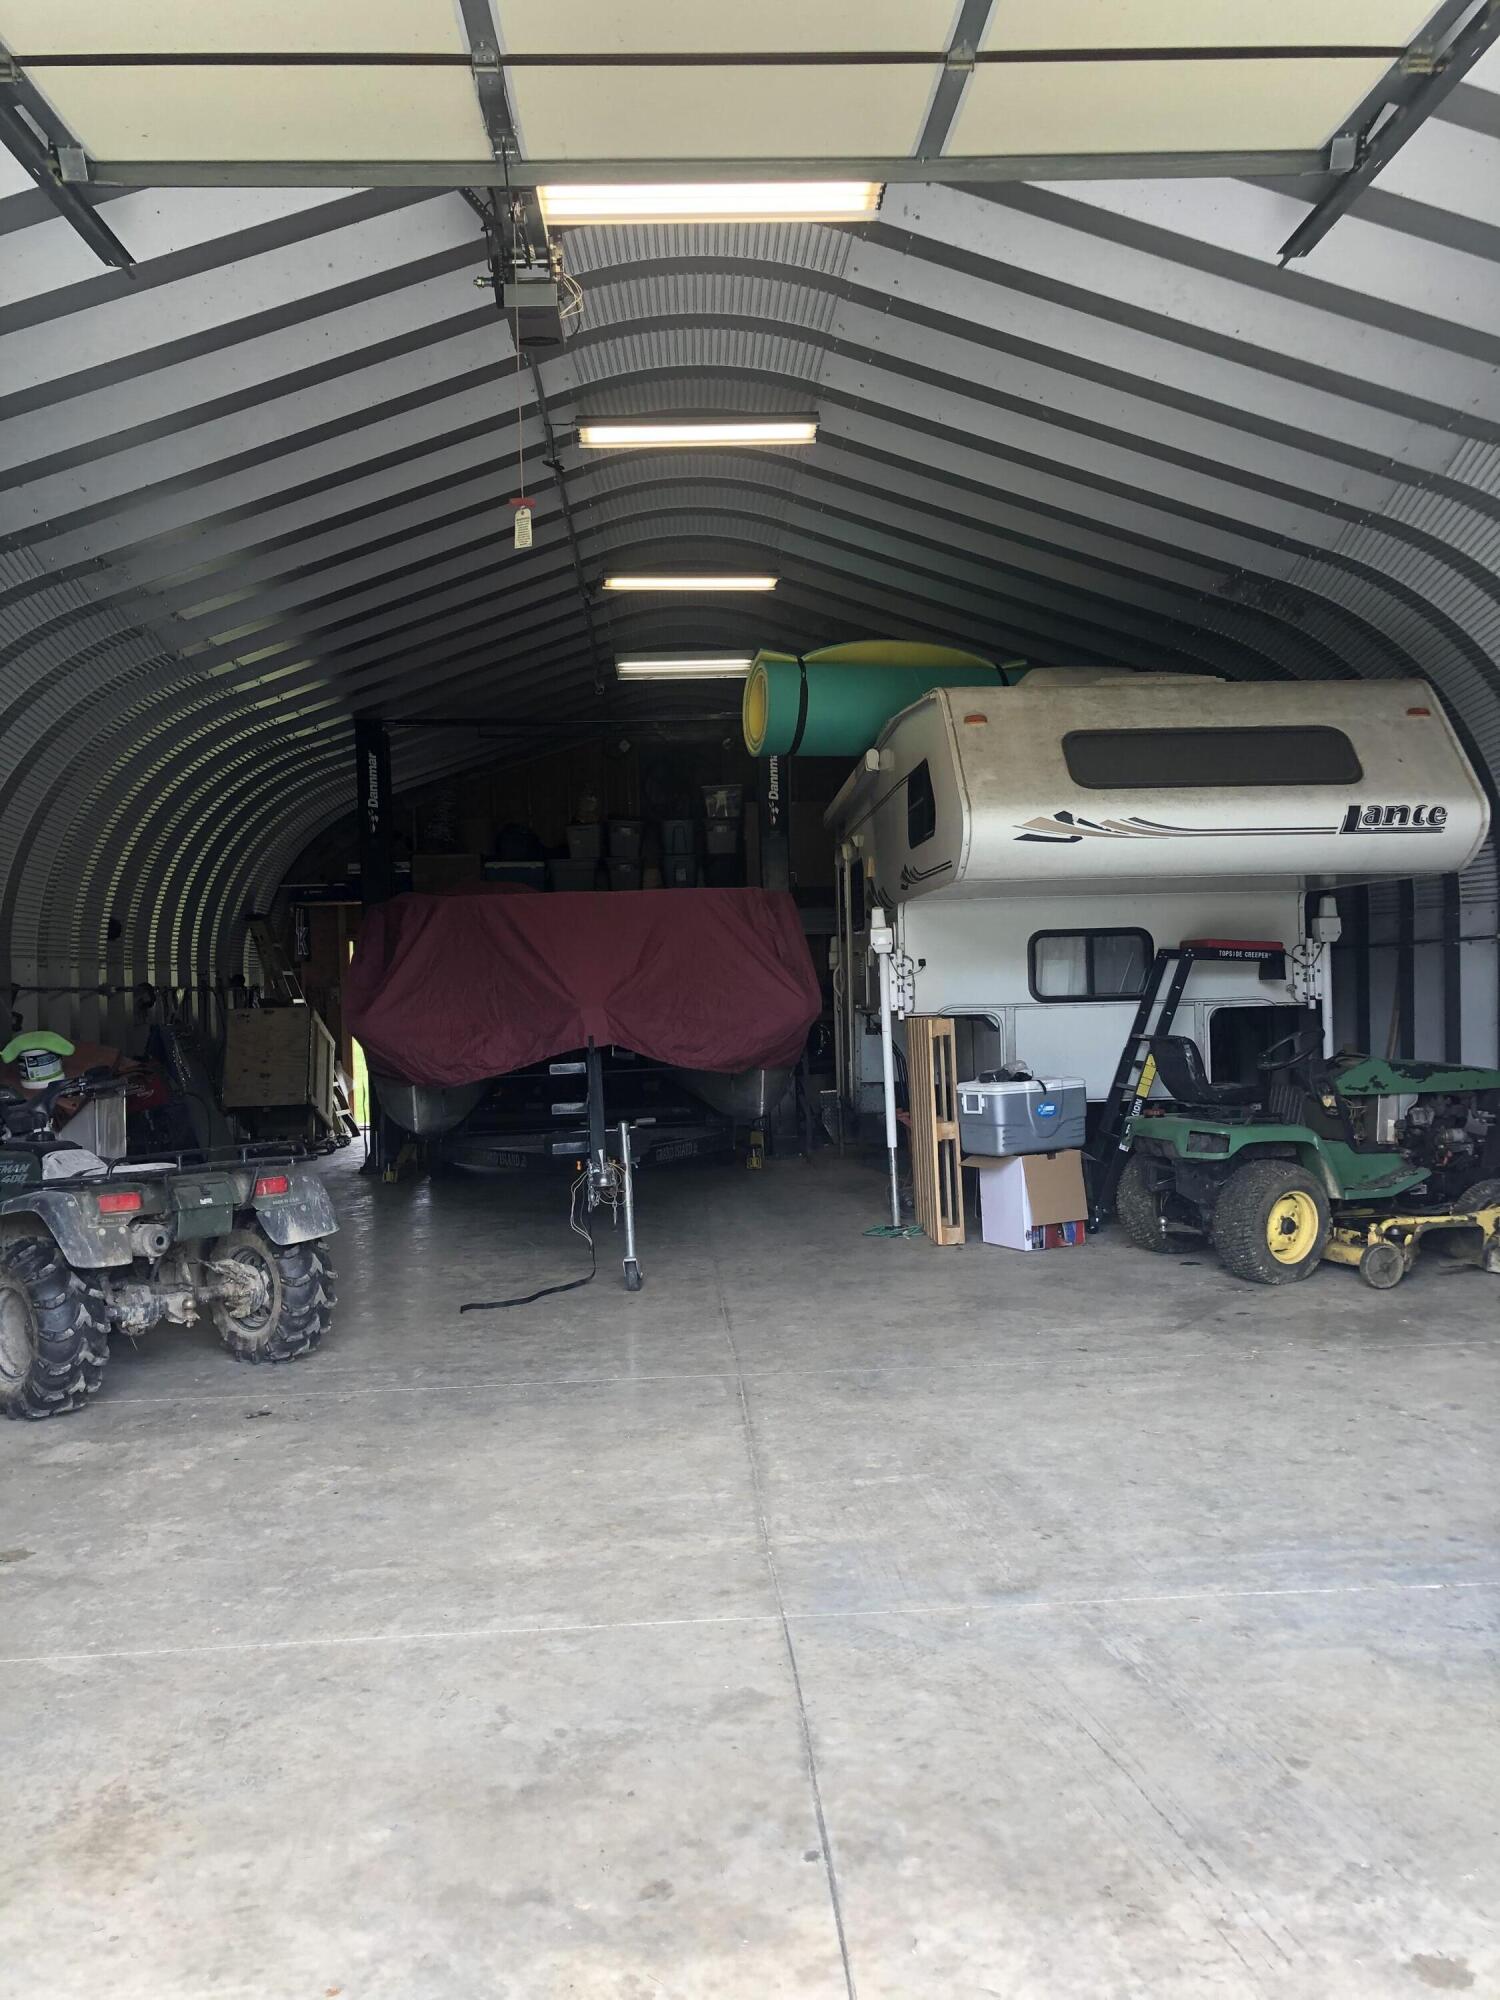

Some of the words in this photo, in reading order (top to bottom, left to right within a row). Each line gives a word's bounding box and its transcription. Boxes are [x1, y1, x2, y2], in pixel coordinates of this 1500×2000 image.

[367, 751, 379, 808] Dannmar
[1340, 804, 1448, 834] Lance
[1219, 950, 1243, 958] TOPSIDE
